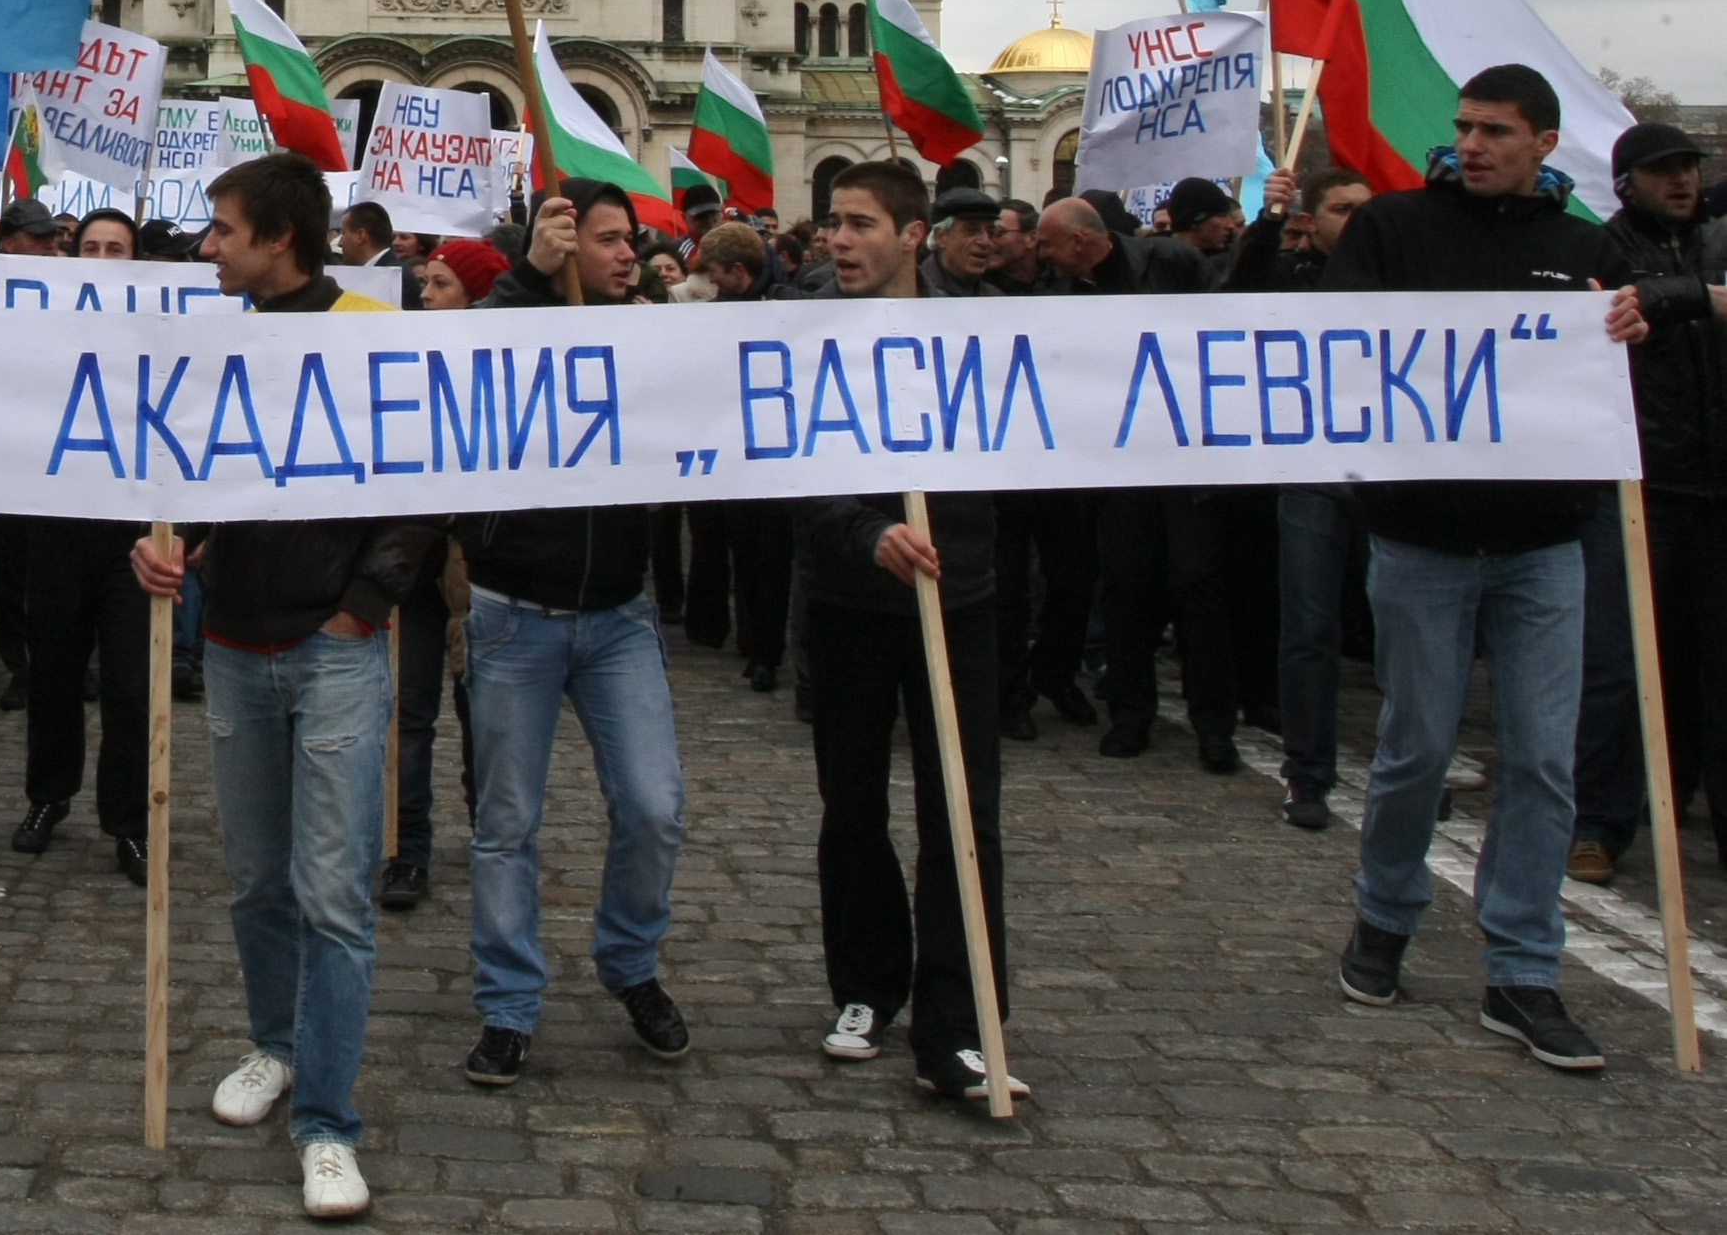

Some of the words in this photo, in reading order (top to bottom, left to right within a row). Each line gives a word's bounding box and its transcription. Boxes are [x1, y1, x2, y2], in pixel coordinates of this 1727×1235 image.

[1127, 21, 1214, 69] УНСС
[1099, 52, 1256, 116] ПОДКРЕПЯ
[103, 88, 140, 126] ЗА
[392, 93, 441, 129] НБУ
[1135, 99, 1206, 145] НСА
[158, 149, 203, 169] НСА!
[370, 125, 394, 157] ЗА
[370, 160, 405, 193] НА
[417, 165, 478, 200] НСА
[46, 345, 623, 488] АКАДЕМИЯ
[677, 335, 1057, 478] „ВАСИЛ
[1115, 312, 1560, 449] ЛЕВСКИ“
